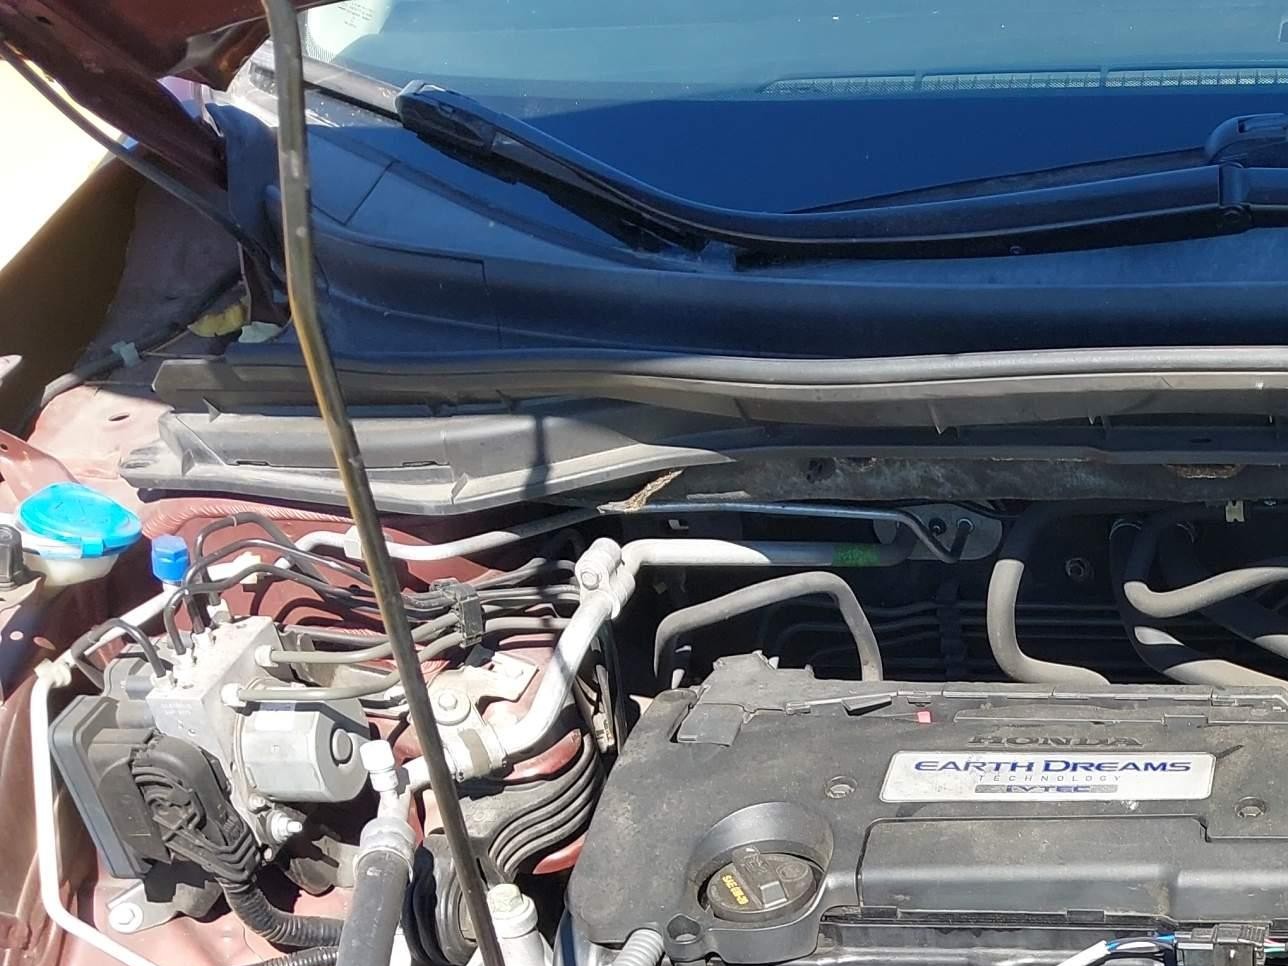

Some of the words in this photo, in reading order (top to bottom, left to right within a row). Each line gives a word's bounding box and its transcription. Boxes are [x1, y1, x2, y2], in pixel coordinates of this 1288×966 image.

[967, 735, 1144, 748] HONDA
[914, 760, 1034, 773] EARTH
[1043, 759, 1192, 773] DREAMS
[979, 775, 1121, 783] TECHNOLOGY
